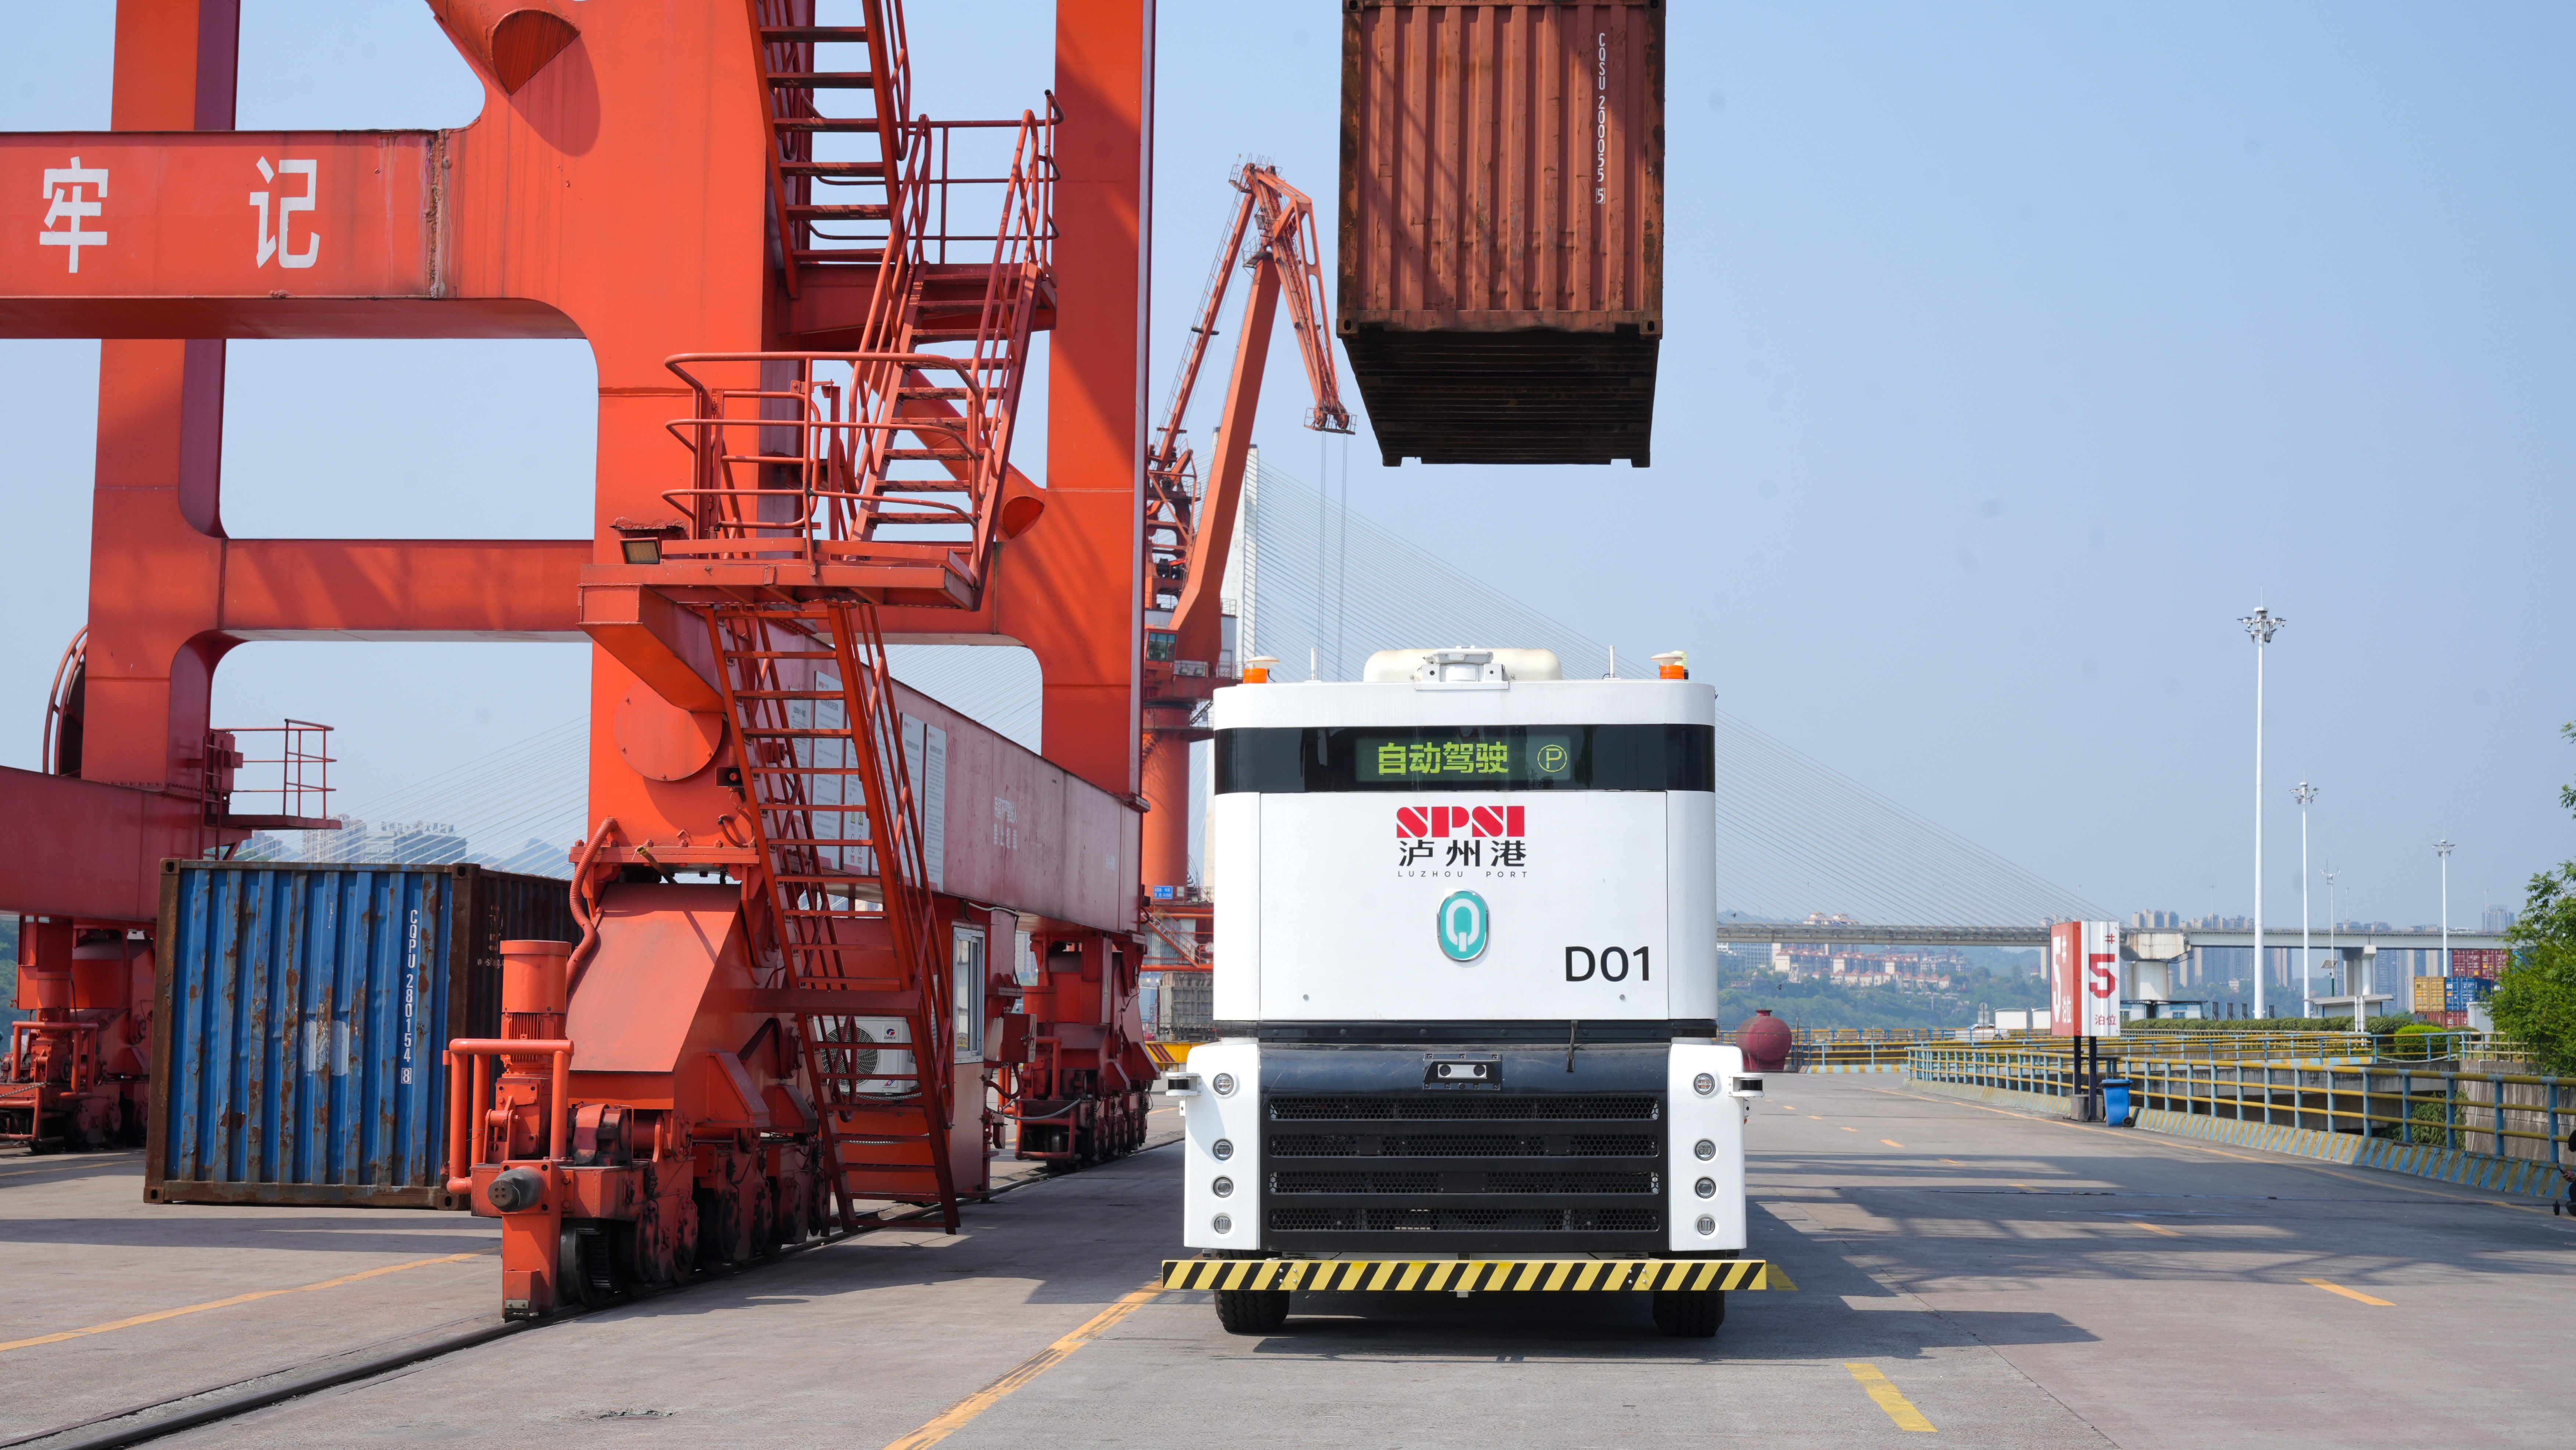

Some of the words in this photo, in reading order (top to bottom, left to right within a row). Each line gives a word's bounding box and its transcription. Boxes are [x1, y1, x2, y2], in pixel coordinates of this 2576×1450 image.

[1597, 189, 1604, 203] 5
[39, 156, 320, 273] 牢记
[1378, 741, 1509, 775] 自动驾驶
[1396, 806, 1525, 838] SPSI
[1399, 839, 1527, 867] 泸州港
[408, 909, 418, 968] CQPU
[1566, 946, 1649, 982] D01
[2089, 953, 2116, 999] 5
[403, 974, 414, 1062] 280154
[2062, 995, 2071, 1024] 泊位
[2095, 1014, 2117, 1025] 泊位
[402, 1069, 410, 1083] 8
